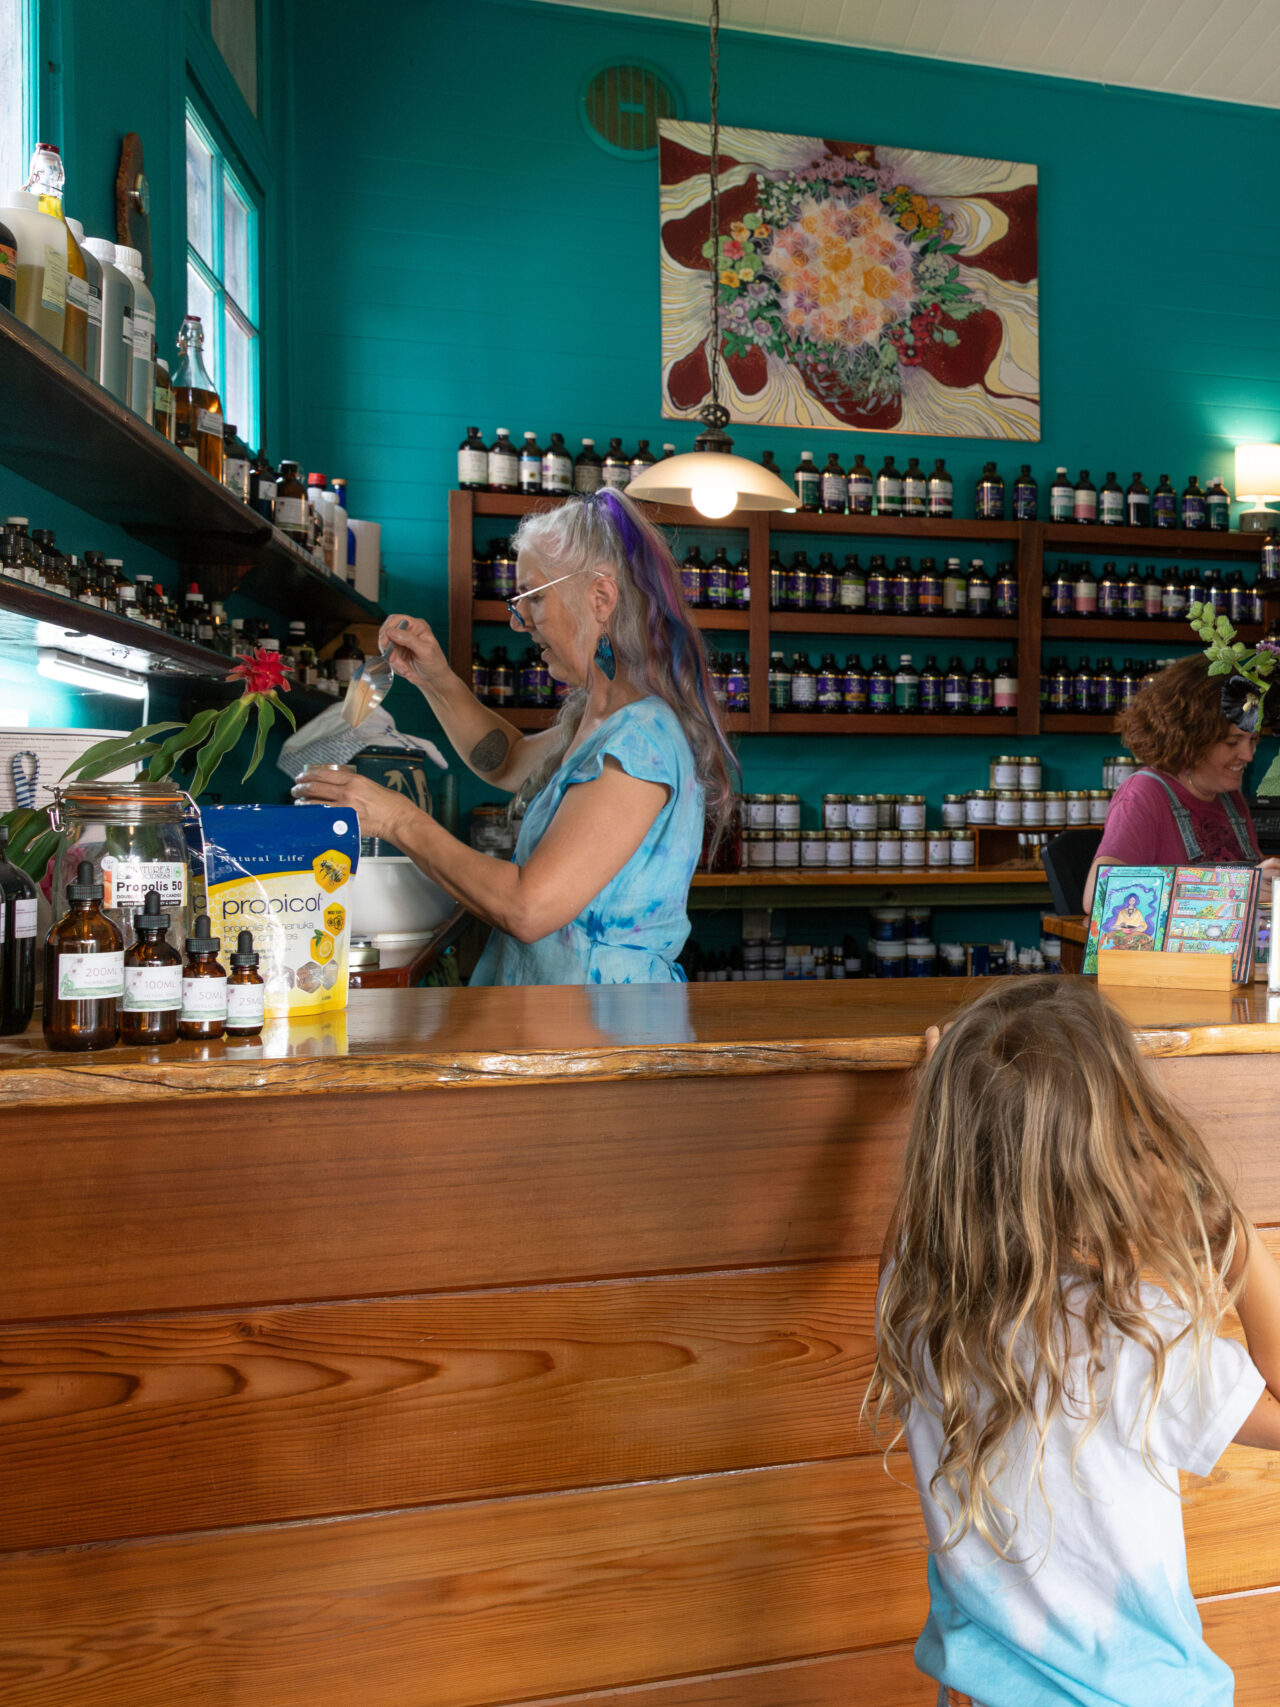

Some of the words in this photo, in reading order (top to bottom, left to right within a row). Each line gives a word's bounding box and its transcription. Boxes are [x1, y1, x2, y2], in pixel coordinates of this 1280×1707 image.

[116, 880, 169, 894] Propolis
[171, 880, 183, 891] 50
[222, 893, 322, 920] propicol
[85, 967, 118, 978] 200ML
[144, 980, 177, 990] 100ML
[199, 991, 223, 1000] 50ML
